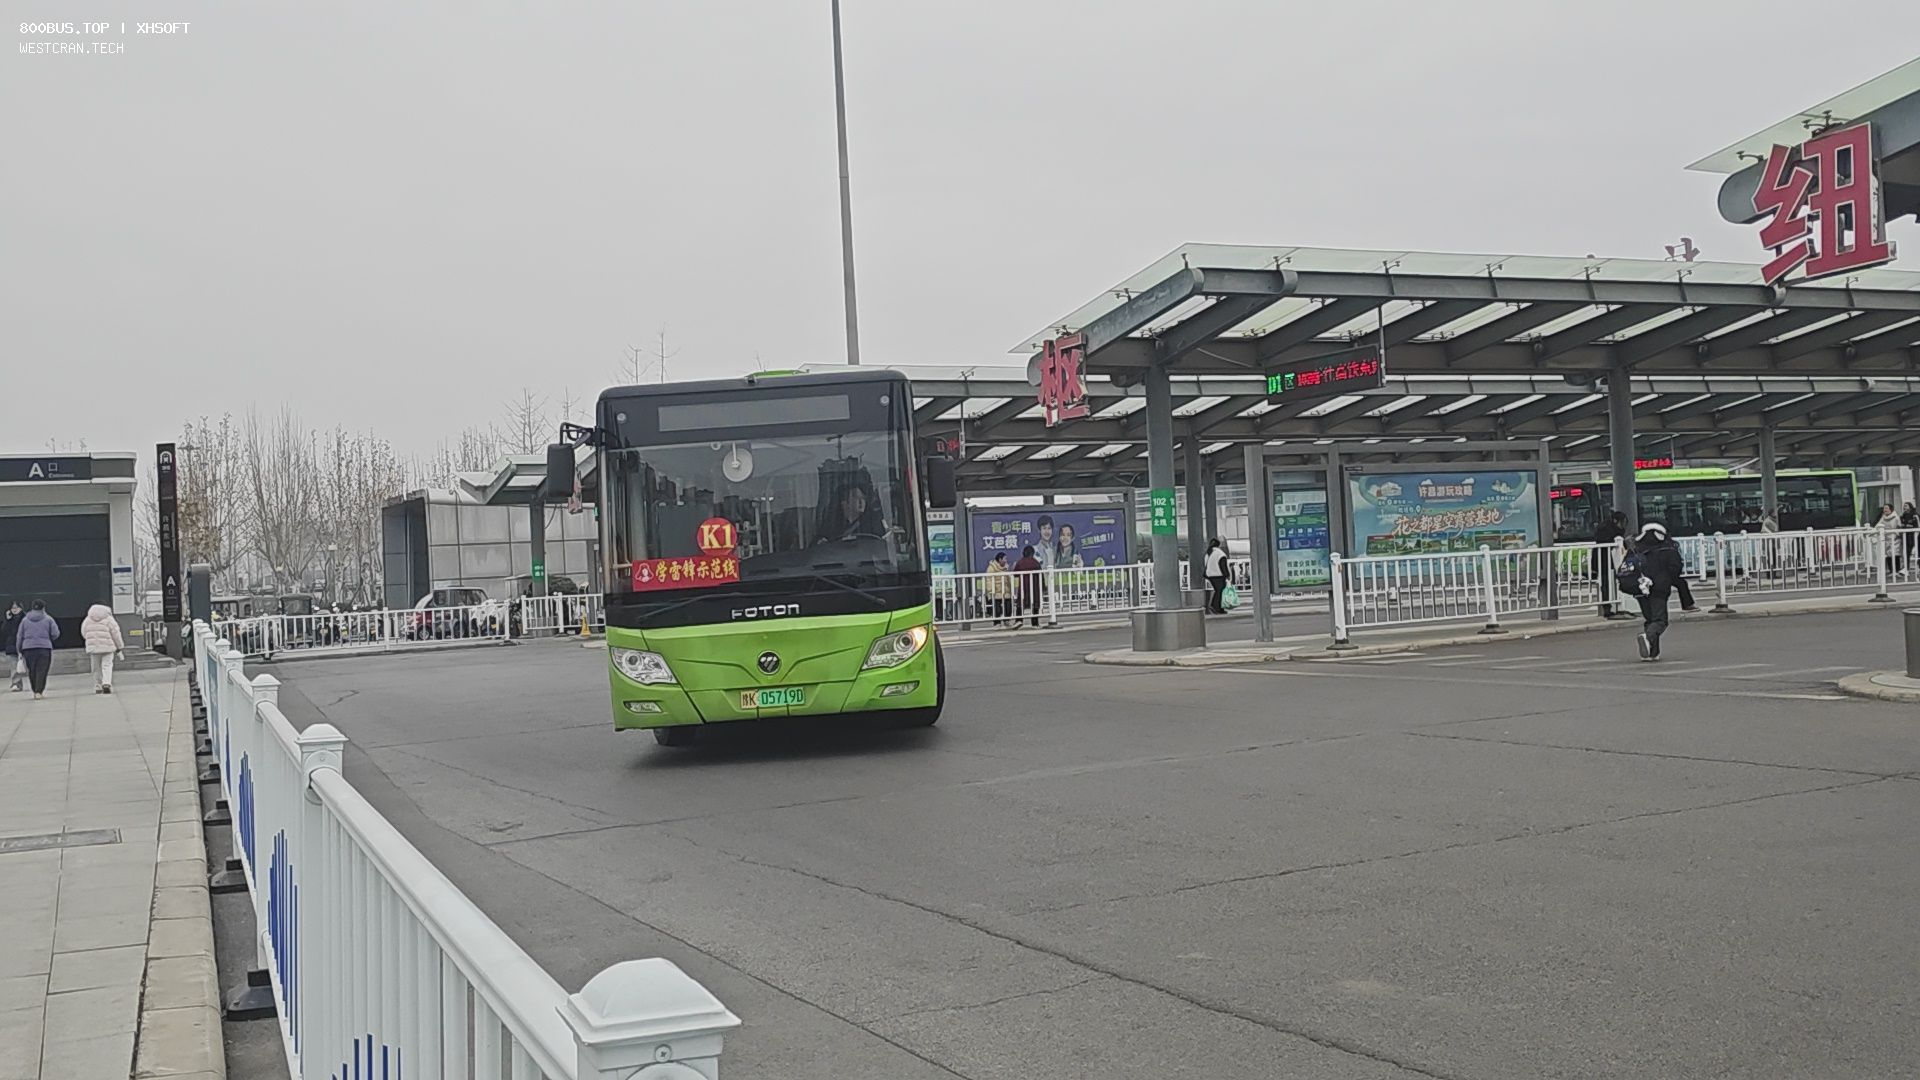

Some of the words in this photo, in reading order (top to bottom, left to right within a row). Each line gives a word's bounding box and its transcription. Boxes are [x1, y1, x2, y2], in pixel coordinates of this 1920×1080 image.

[1752, 120, 1892, 286] 纽
[1036, 332, 1090, 428] 枢
[28, 462, 45, 478] A
[1152, 497, 1167, 506] 102
[991, 520, 1031, 534] 青少年用
[1392, 508, 1505, 539] 花之都星空露营基地
[700, 523, 735, 550] K1
[655, 557, 739, 583] 学雷锋示范线
[166, 575, 176, 587] A
[731, 603, 800, 620] FOTON
[761, 688, 804, 705] 05719D
